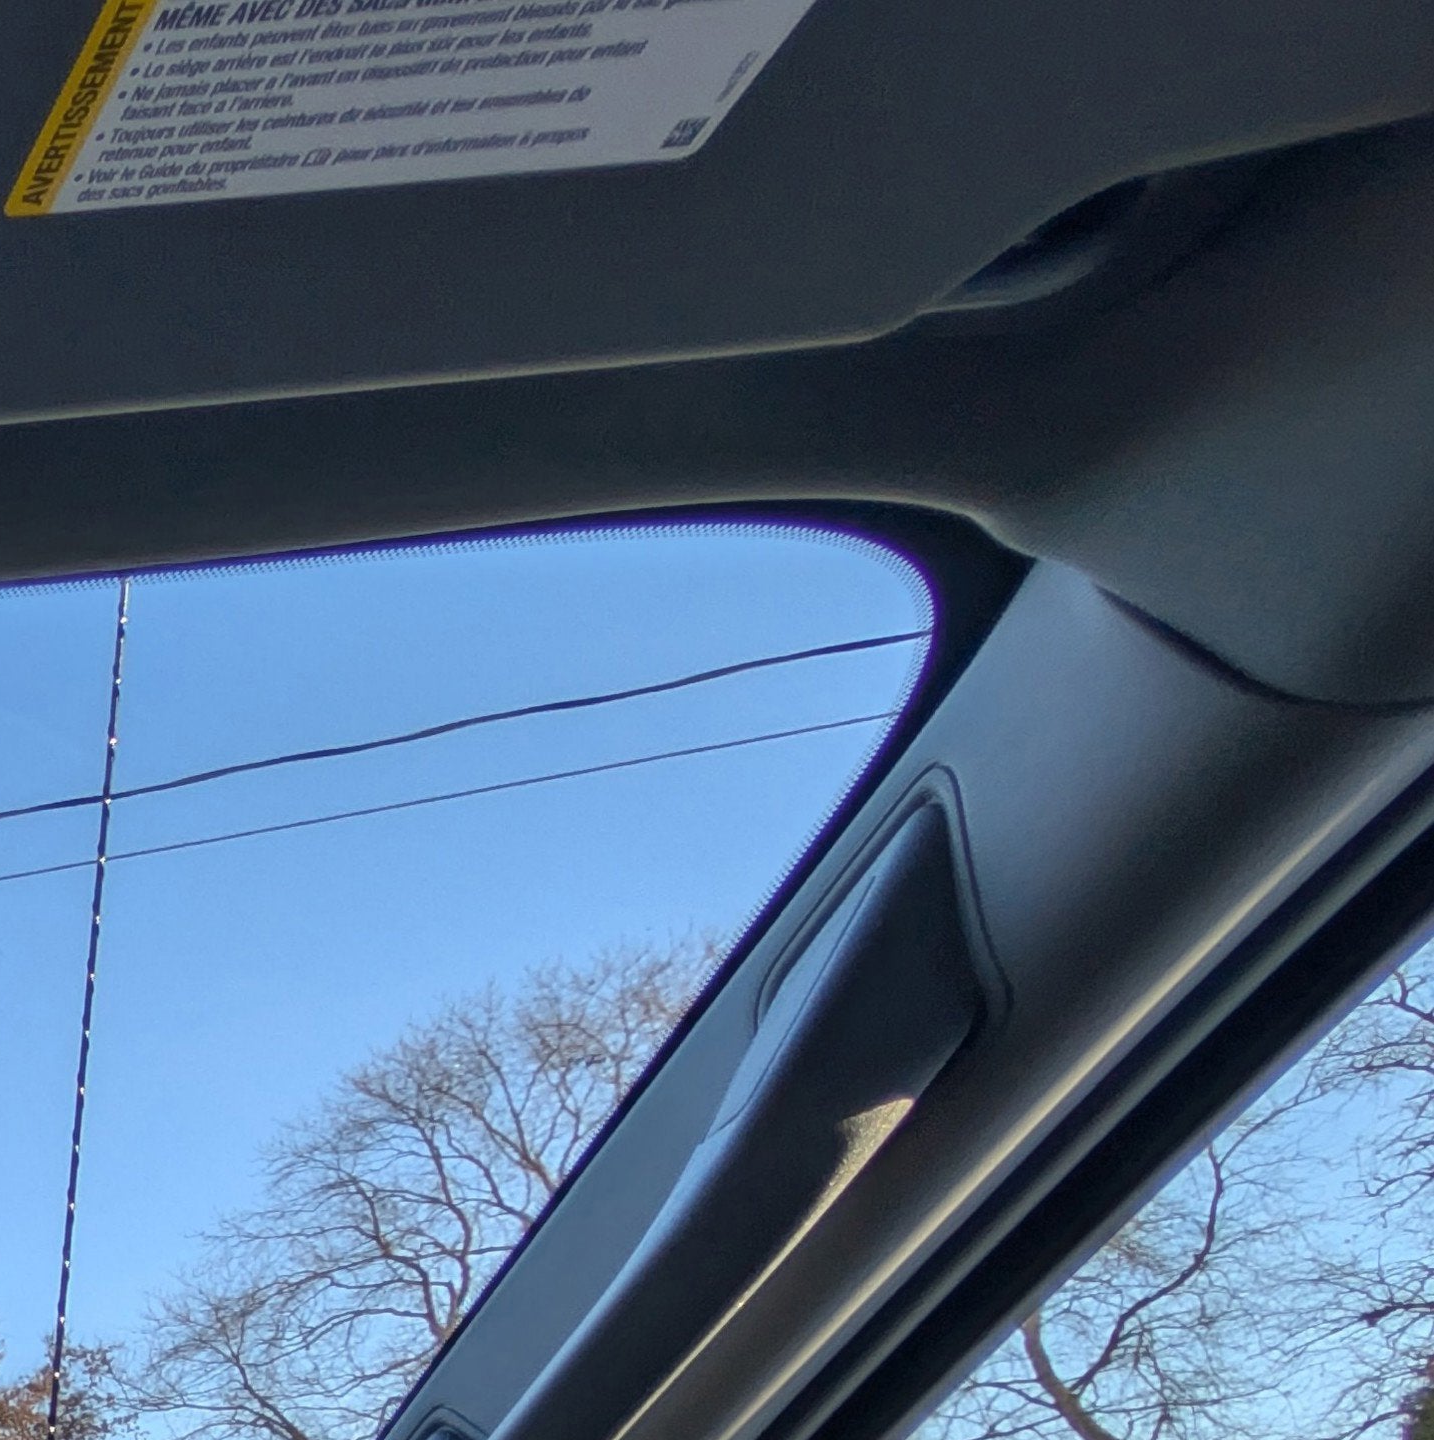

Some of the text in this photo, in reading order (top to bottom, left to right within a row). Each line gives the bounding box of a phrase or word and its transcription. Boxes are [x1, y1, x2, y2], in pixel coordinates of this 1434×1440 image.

[154, 2, 225, 31] MÊME
[228, 0, 291, 26] AVEC
[189, 29, 246, 51] enfants
[250, 24, 318, 48] peuvent
[22, 0, 145, 206] AVERTISSEMENT
[110, 124, 175, 147] Toujours
[159, 142, 198, 161] pour
[88, 165, 119, 184] Voir
[138, 160, 182, 181] Guide
[185, 158, 206, 176] du
